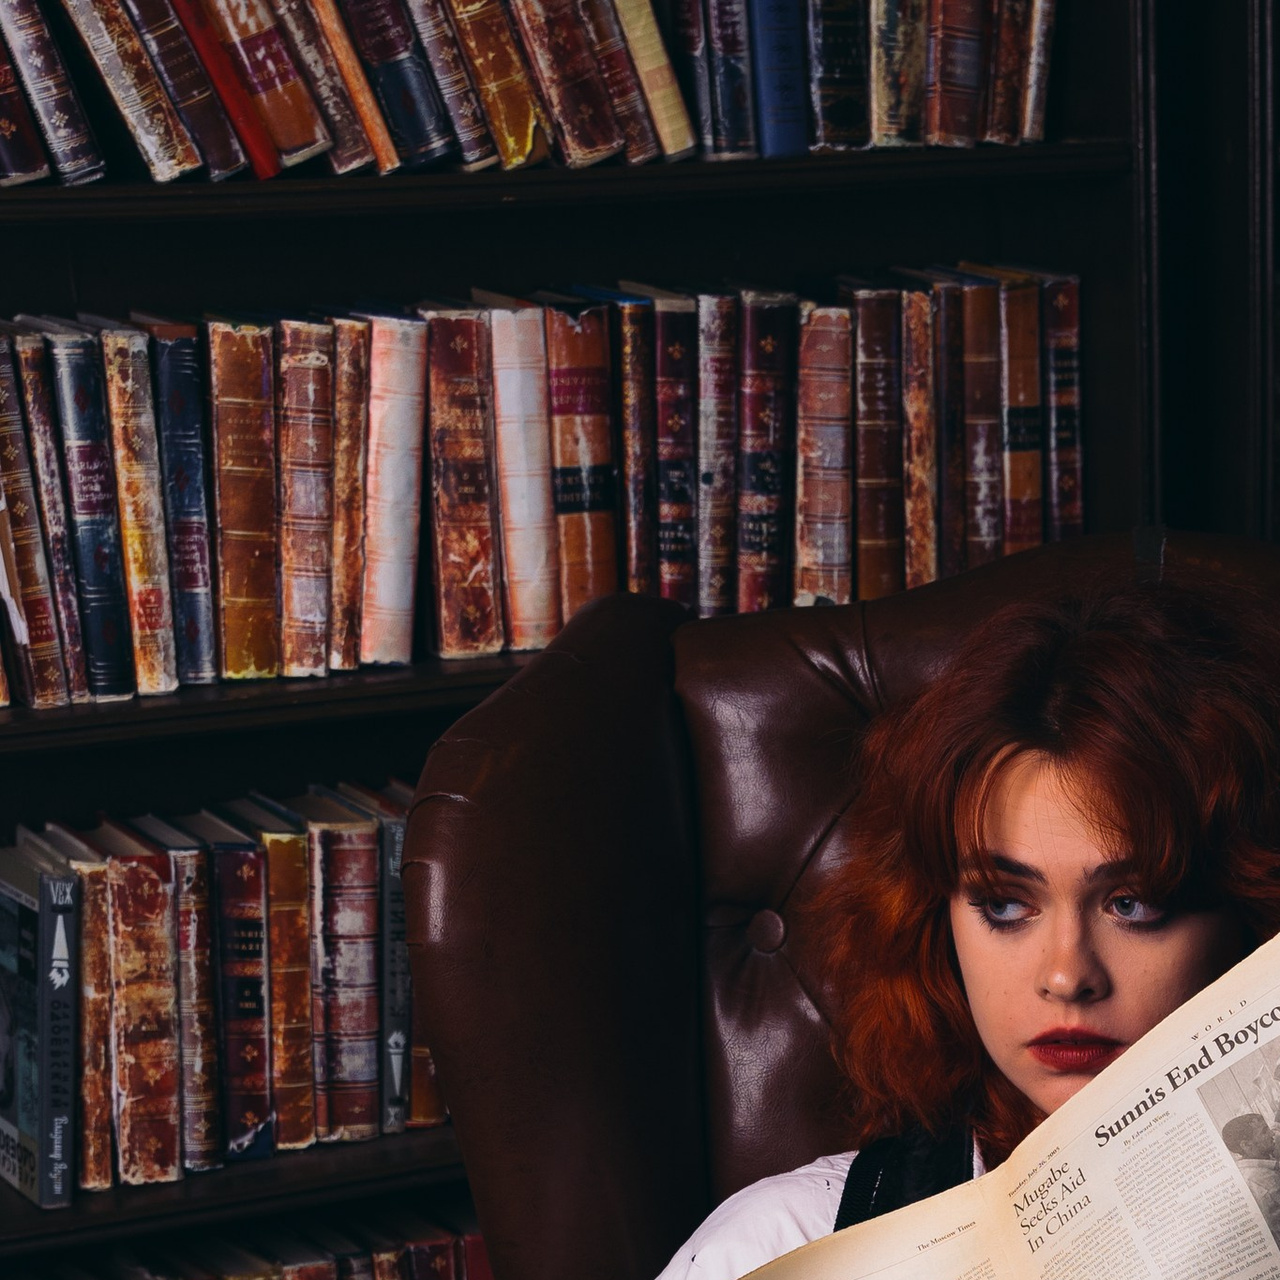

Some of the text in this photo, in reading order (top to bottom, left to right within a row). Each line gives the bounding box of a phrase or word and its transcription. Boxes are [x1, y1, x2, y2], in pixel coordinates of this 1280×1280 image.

[1190, 999, 1247, 1041] WORLD
[1093, 1086, 1166, 1148] Sunnis
[1163, 1044, 1216, 1093] End
[1012, 1161, 1070, 1218] Mugabe
[1019, 1167, 1086, 1236] Seeks Aid
[916, 1220, 976, 1252] The Moscow Times
[1026, 1194, 1092, 1254] In China
